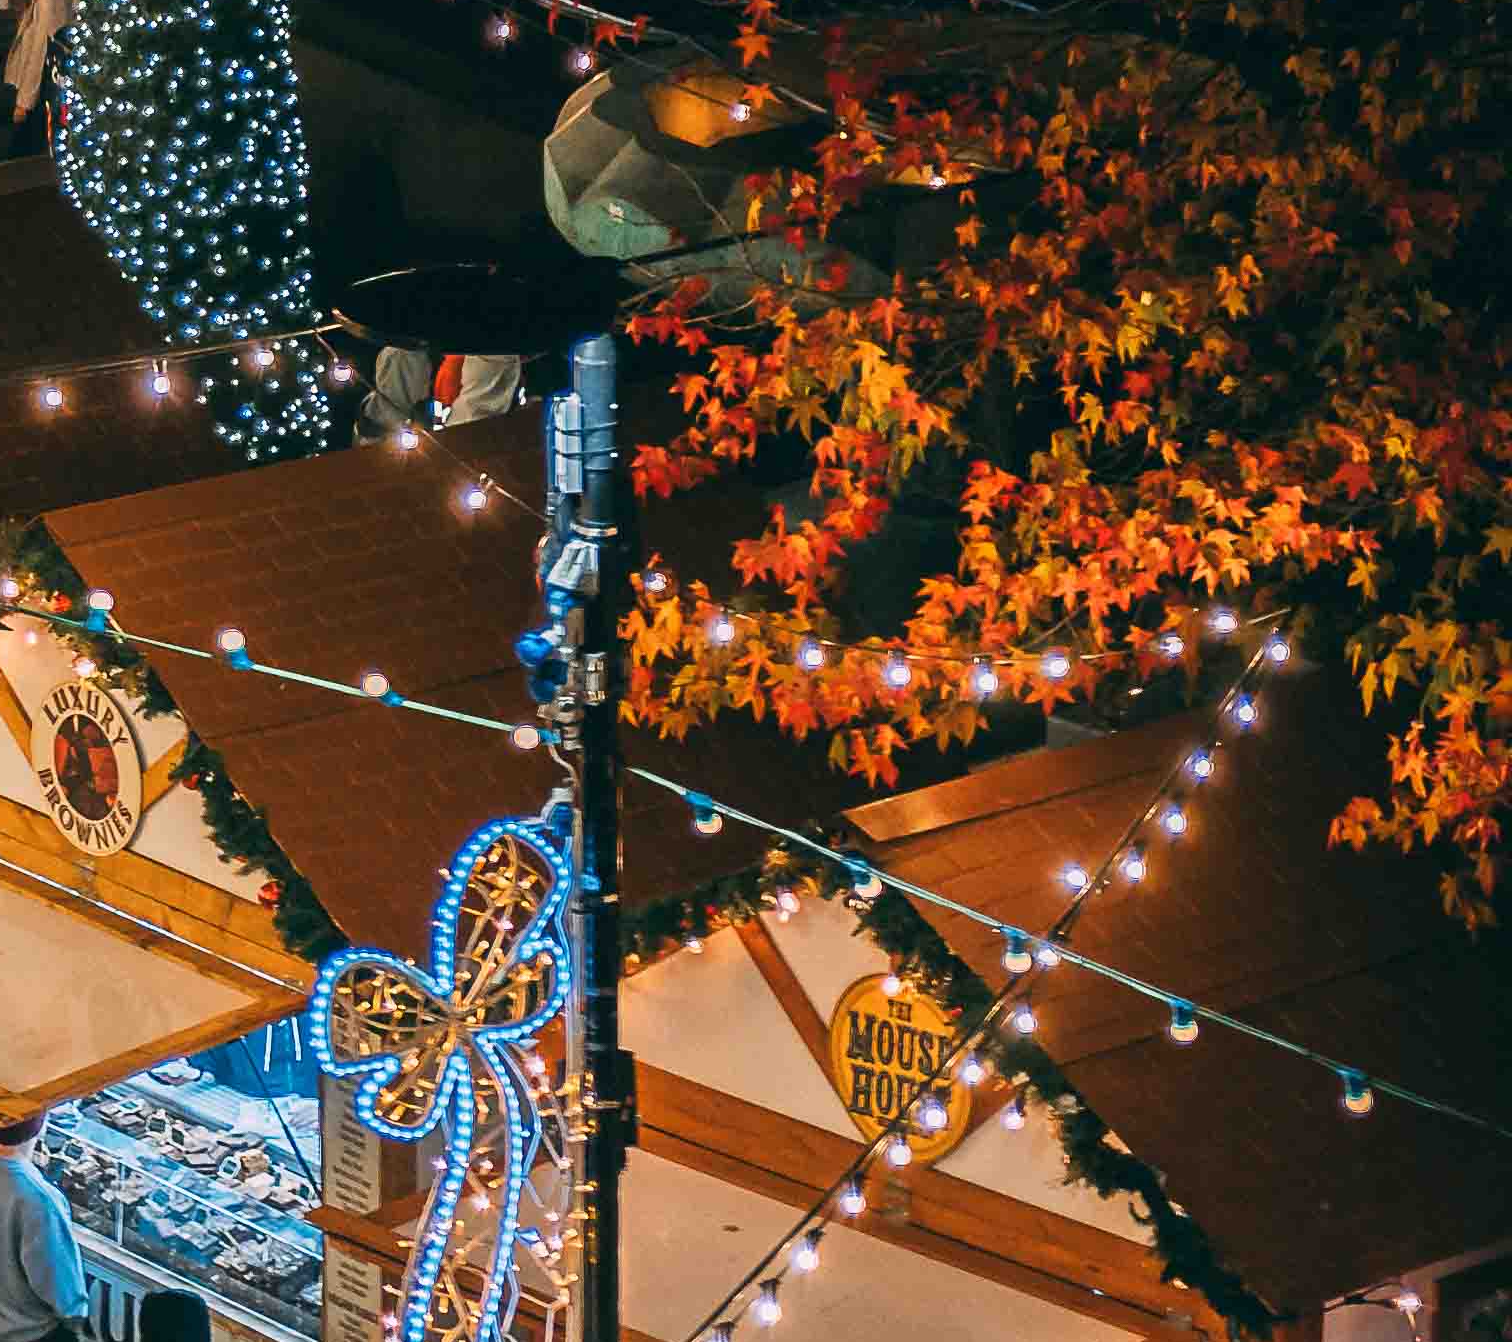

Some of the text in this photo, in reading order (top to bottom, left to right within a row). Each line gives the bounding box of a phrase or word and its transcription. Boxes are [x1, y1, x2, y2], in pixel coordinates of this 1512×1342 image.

[42, 685, 129, 746] LUXURY
[37, 767, 133, 850] BROWNIES
[887, 998, 913, 1023] THE
